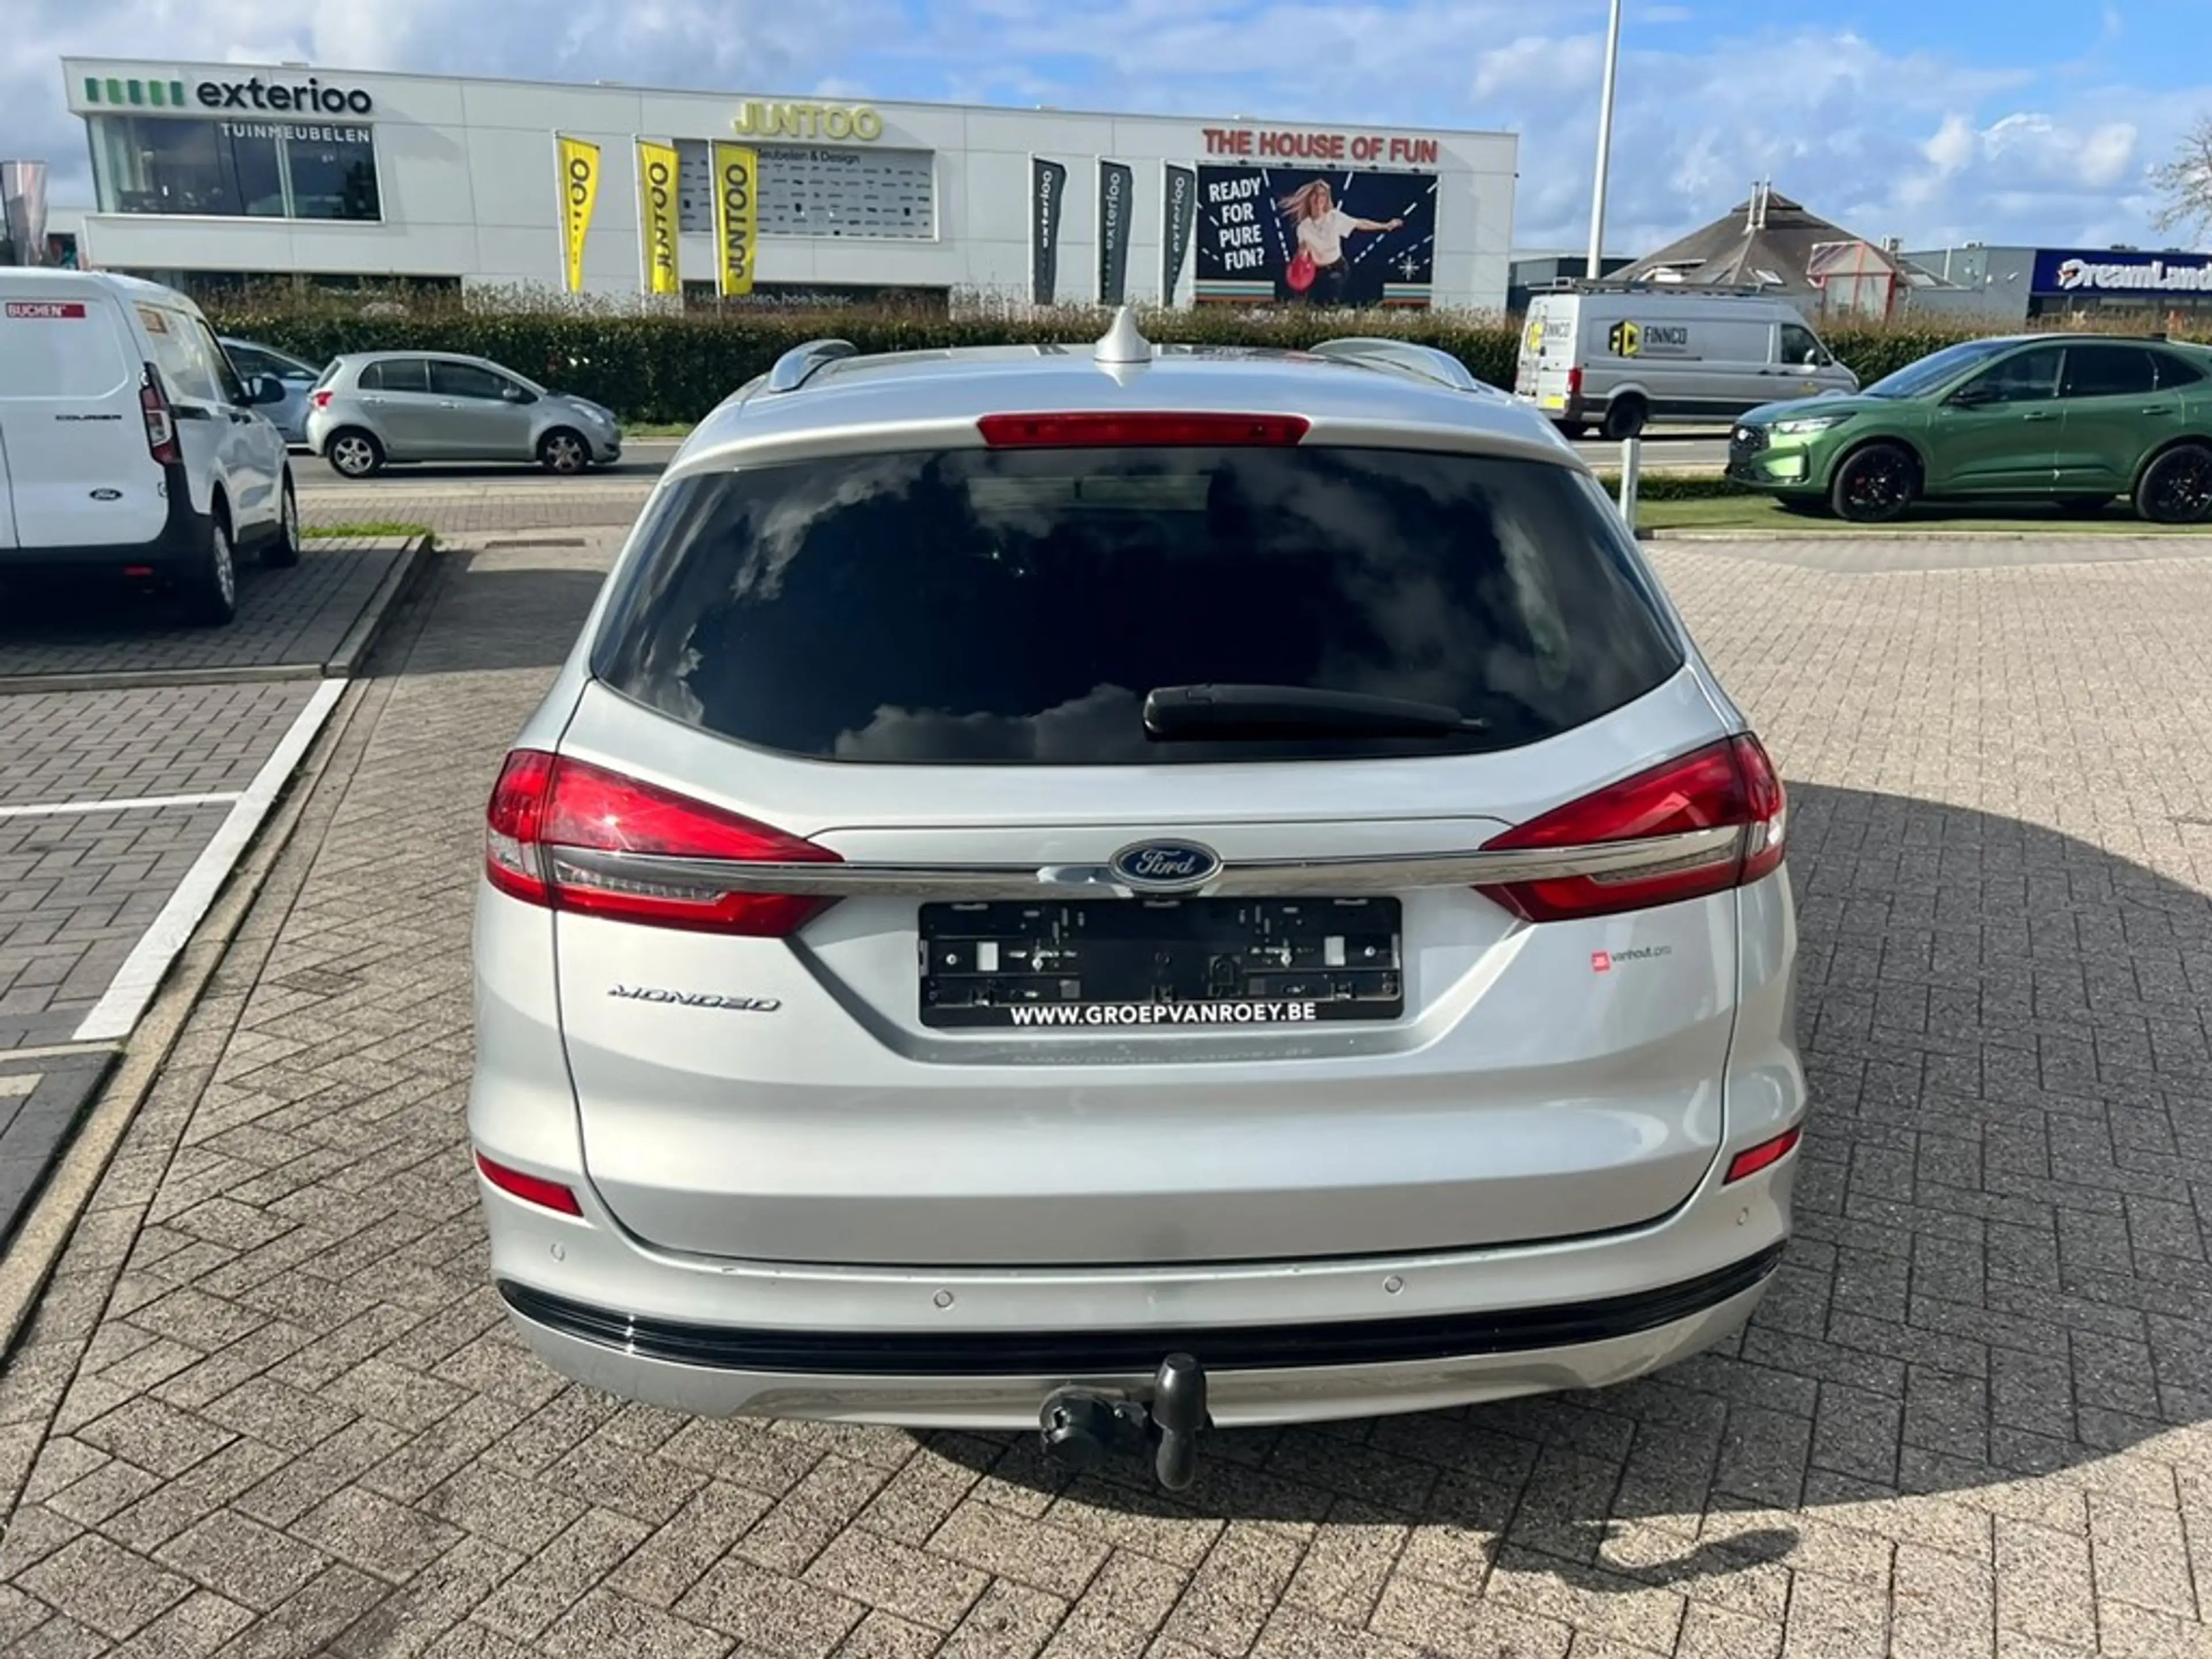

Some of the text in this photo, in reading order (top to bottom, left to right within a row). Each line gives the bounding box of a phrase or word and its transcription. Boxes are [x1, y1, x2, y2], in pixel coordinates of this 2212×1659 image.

[196, 77, 373, 114] exterioo
[221, 122, 370, 143] TUINMEUBELEN
[730, 103, 882, 141] JUNTOO
[1203, 128, 1439, 164] THE HOUSE OF FUN
[1209, 176, 1262, 203] READY
[724, 164, 748, 279] JUNTOO
[1104, 173, 1120, 250] exterioo
[1221, 202, 1255, 224] FOR
[1218, 224, 1263, 249] PURE
[1224, 248, 1265, 271] FUN?
[1644, 325, 1688, 344] FINNCO
[1135, 850, 1196, 875] Ford
[607, 984, 782, 1012] MONDEO
[1010, 1002, 1317, 1025] WWW.GROEPVANROEY.BE
